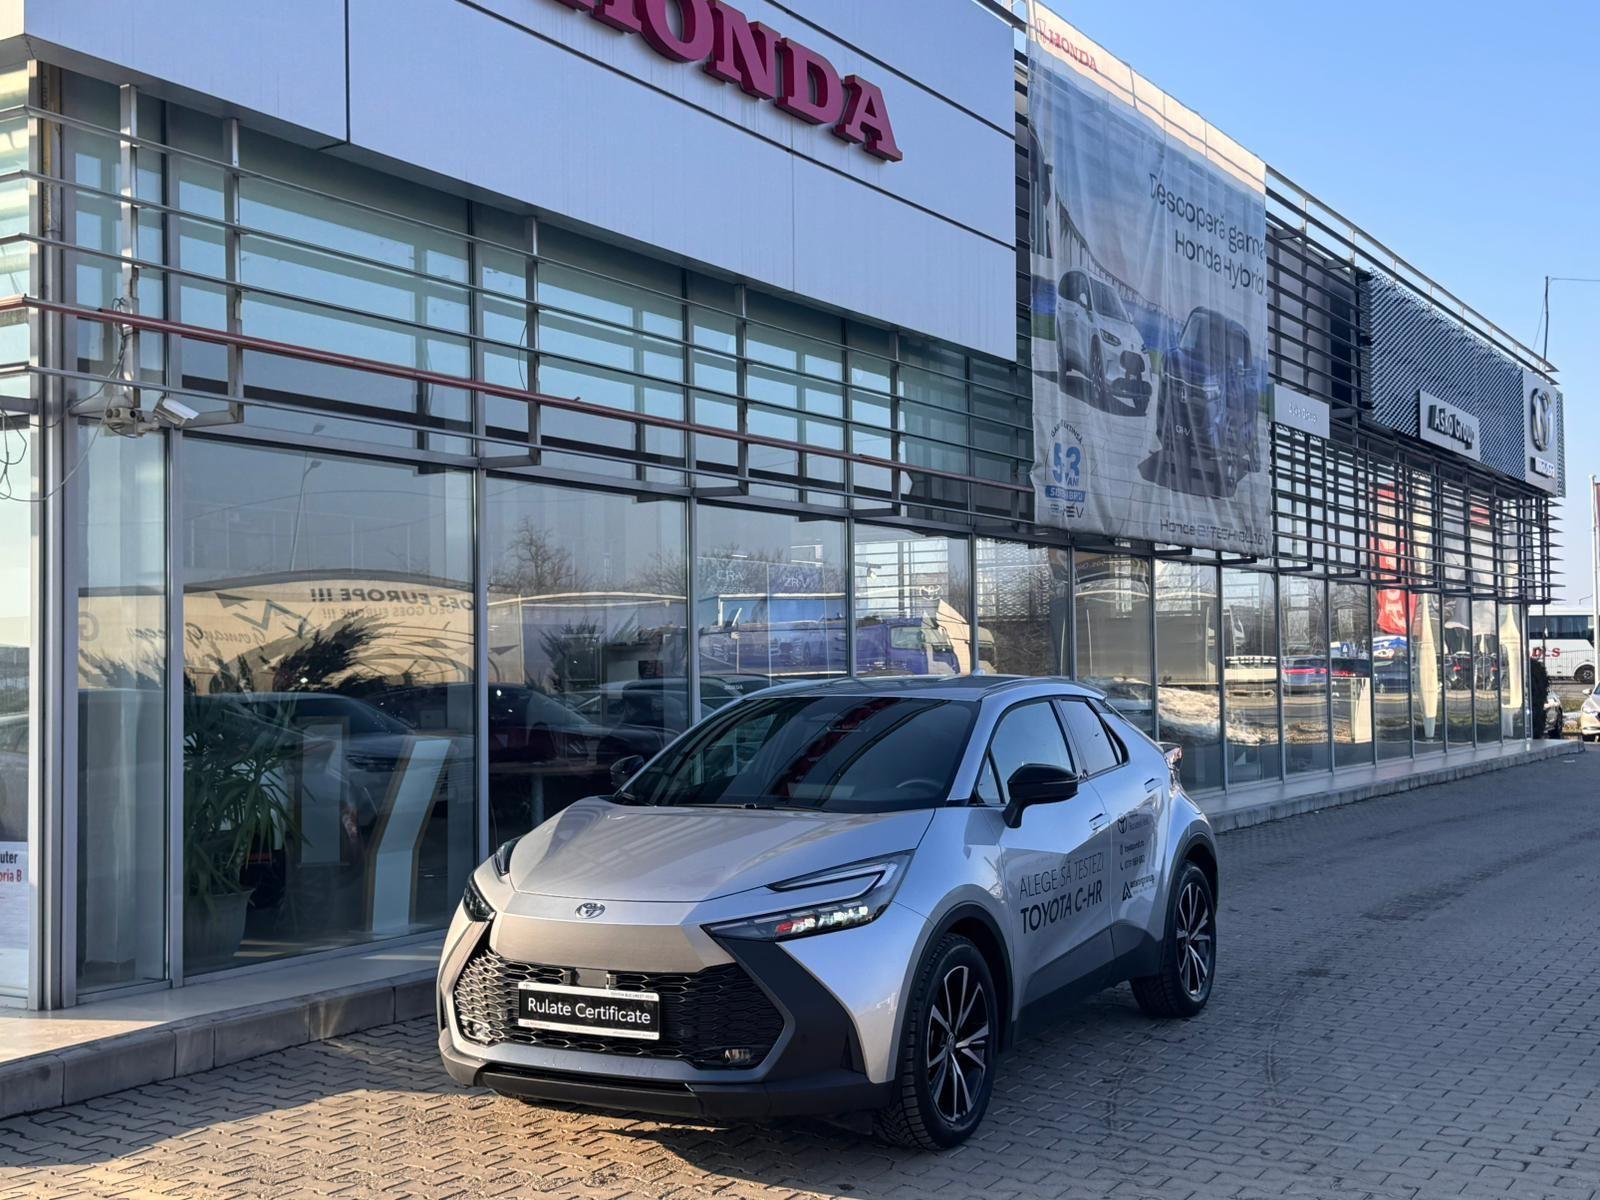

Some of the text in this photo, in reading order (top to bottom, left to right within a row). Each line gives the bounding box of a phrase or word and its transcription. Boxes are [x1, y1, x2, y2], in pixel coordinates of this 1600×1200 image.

[1049, 28, 1098, 72] HONDA
[548, 0, 902, 162] ONDA
[1175, 229, 1222, 273] Honda
[1020, 868, 1057, 900] ALEGE
[1060, 860, 1072, 888] SĂ
[1074, 852, 1104, 882] TESTEZI
[1020, 879, 1103, 934] TOYOTA C-HR
[528, 996, 651, 1025] Rulate Certificate
